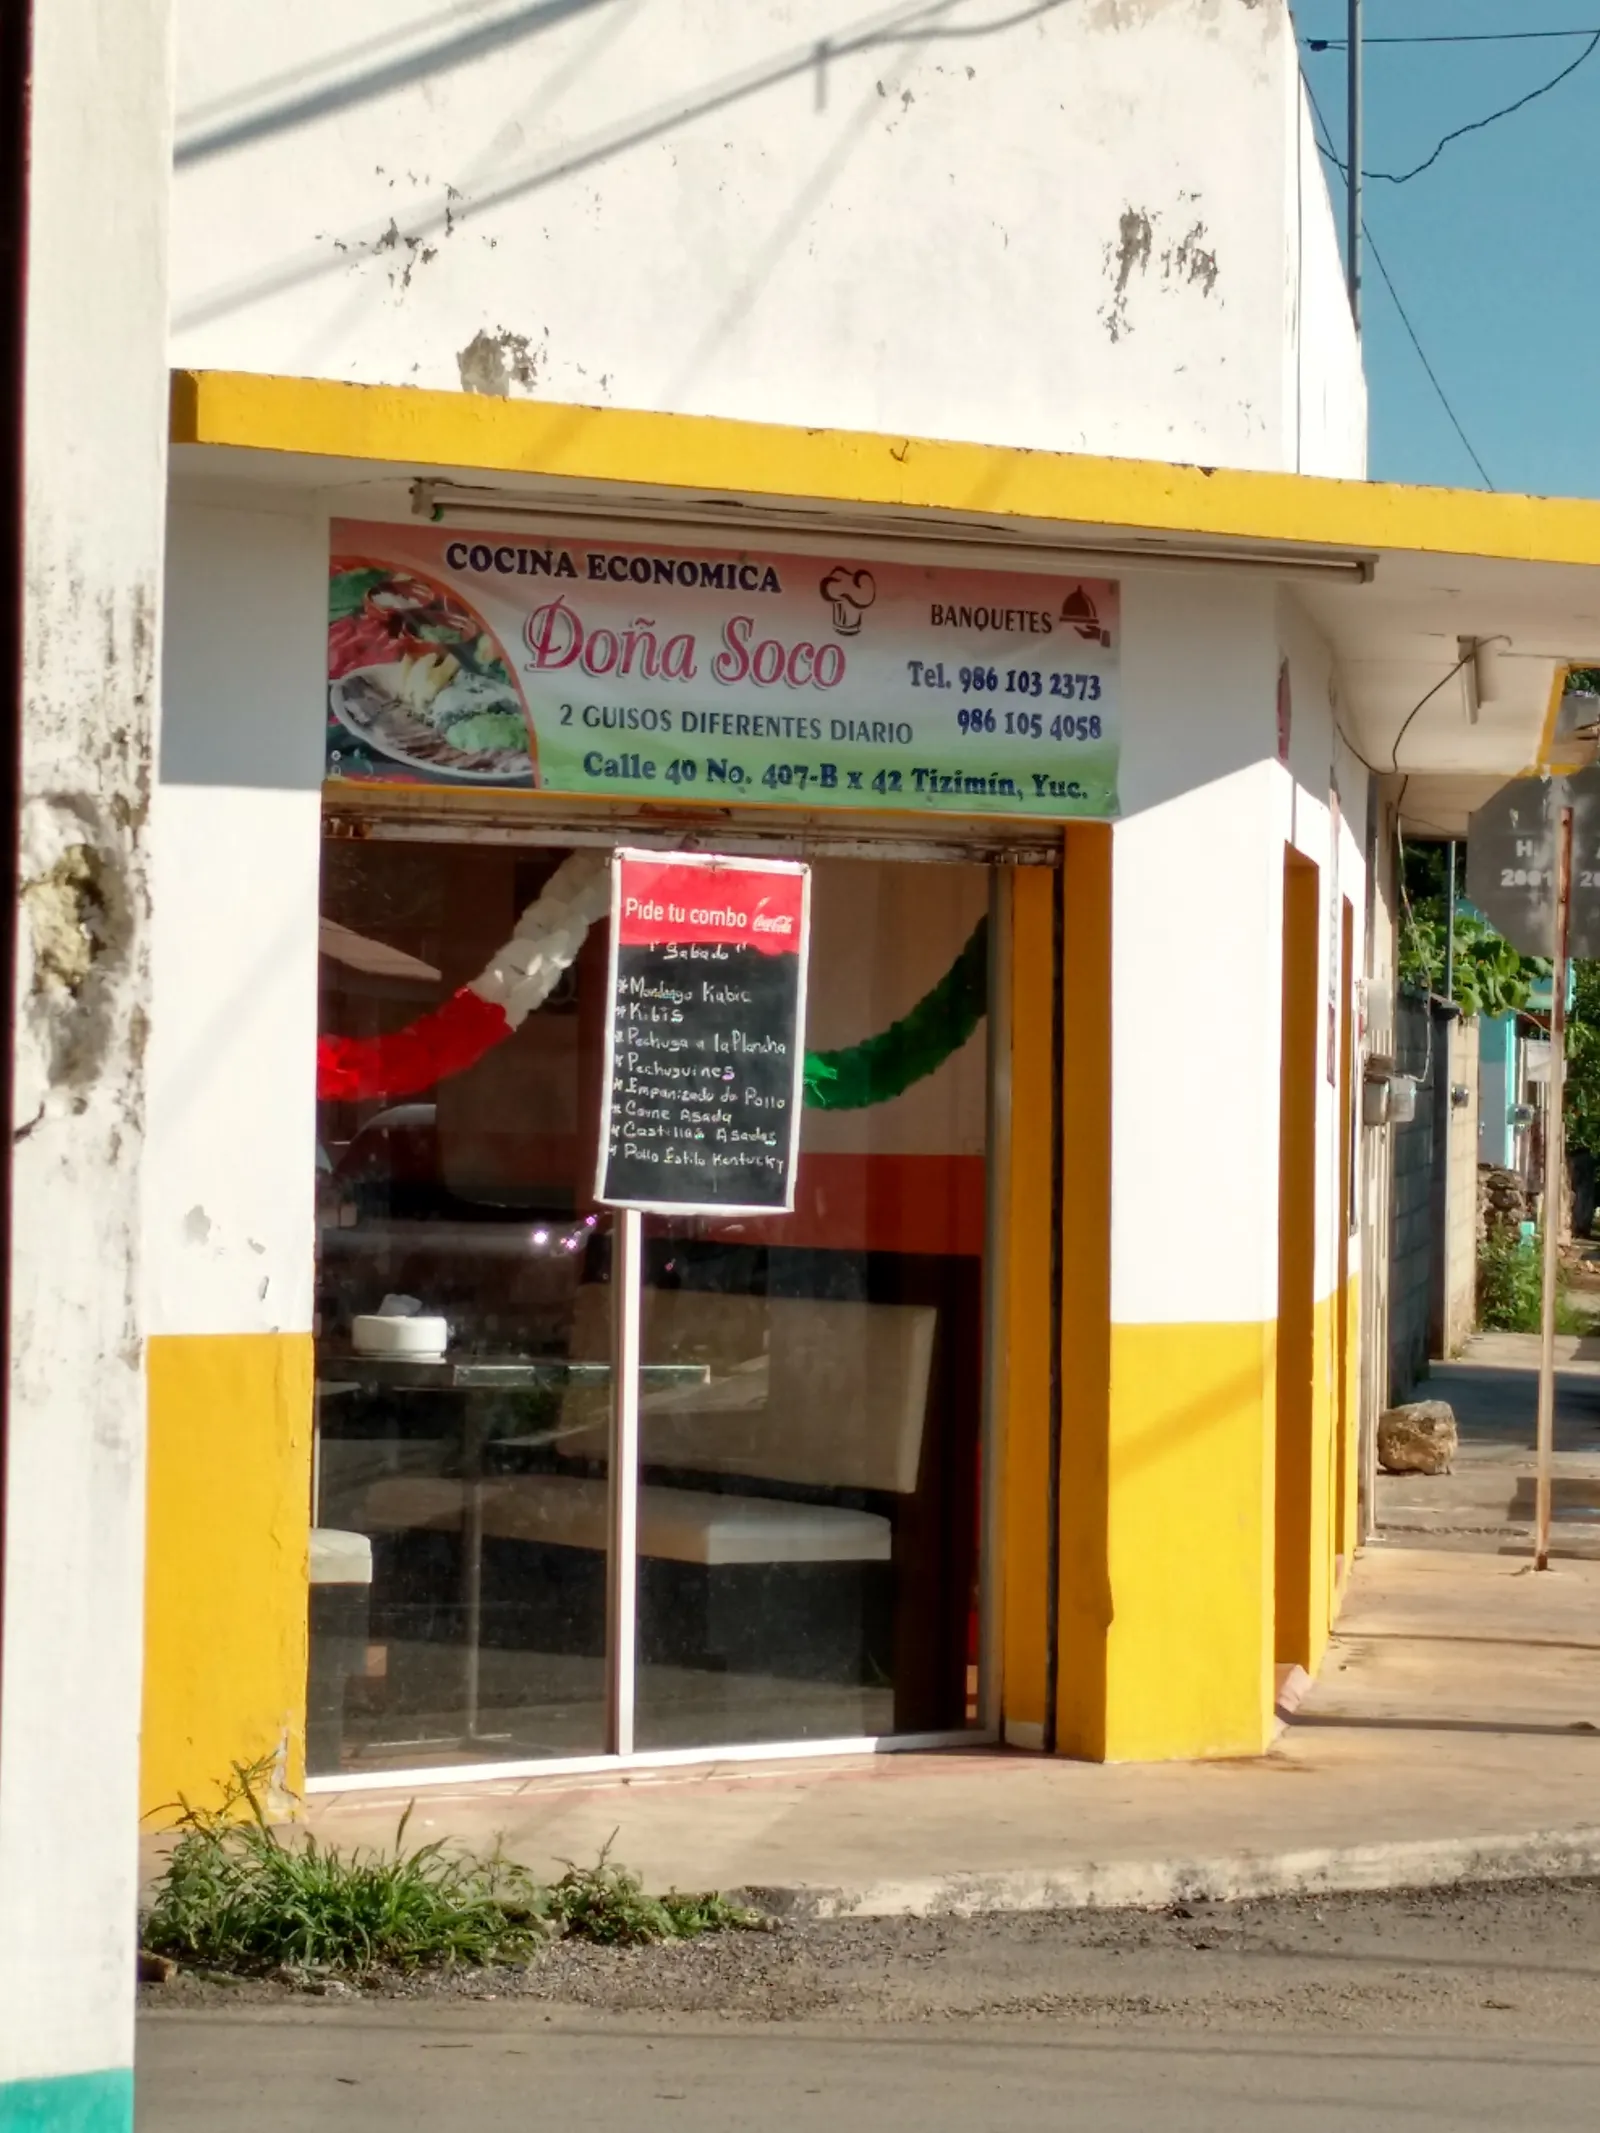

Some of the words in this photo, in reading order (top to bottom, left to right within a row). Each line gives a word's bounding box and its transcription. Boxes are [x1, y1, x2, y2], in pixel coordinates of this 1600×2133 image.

[446, 543, 577, 578] COCINA
[587, 553, 782, 593] ECONOMICA
[931, 604, 1052, 633] BANQUETES
[526, 594, 698, 682] Doña
[714, 615, 846, 689] Soco
[907, 661, 951, 689] Tel.
[958, 667, 998, 694] 986
[1005, 670, 1042, 697] 103
[1049, 673, 1101, 700] 2373
[560, 704, 573, 726] 2
[582, 705, 672, 732] GUISOS
[682, 711, 822, 740] DIFERENTES
[830, 719, 913, 745] DIARIO
[957, 709, 996, 736] 986
[1005, 712, 1042, 739] 105
[1050, 715, 1101, 741] 4058
[583, 751, 657, 779] Calle
[665, 759, 697, 785] 40
[706, 758, 752, 784] No.
[762, 763, 838, 790] 407-B
[847, 769, 862, 790] x
[871, 767, 902, 795] 42
[911, 767, 1023, 800] Tizimín,
[1031, 774, 1088, 799] Yuc.
[625, 898, 664, 921] Pide
[668, 903, 685, 923] tu
[689, 907, 747, 928] combo
[626, 1100, 670, 1120] Carne
[745, 1087, 785, 1108] Pollo
